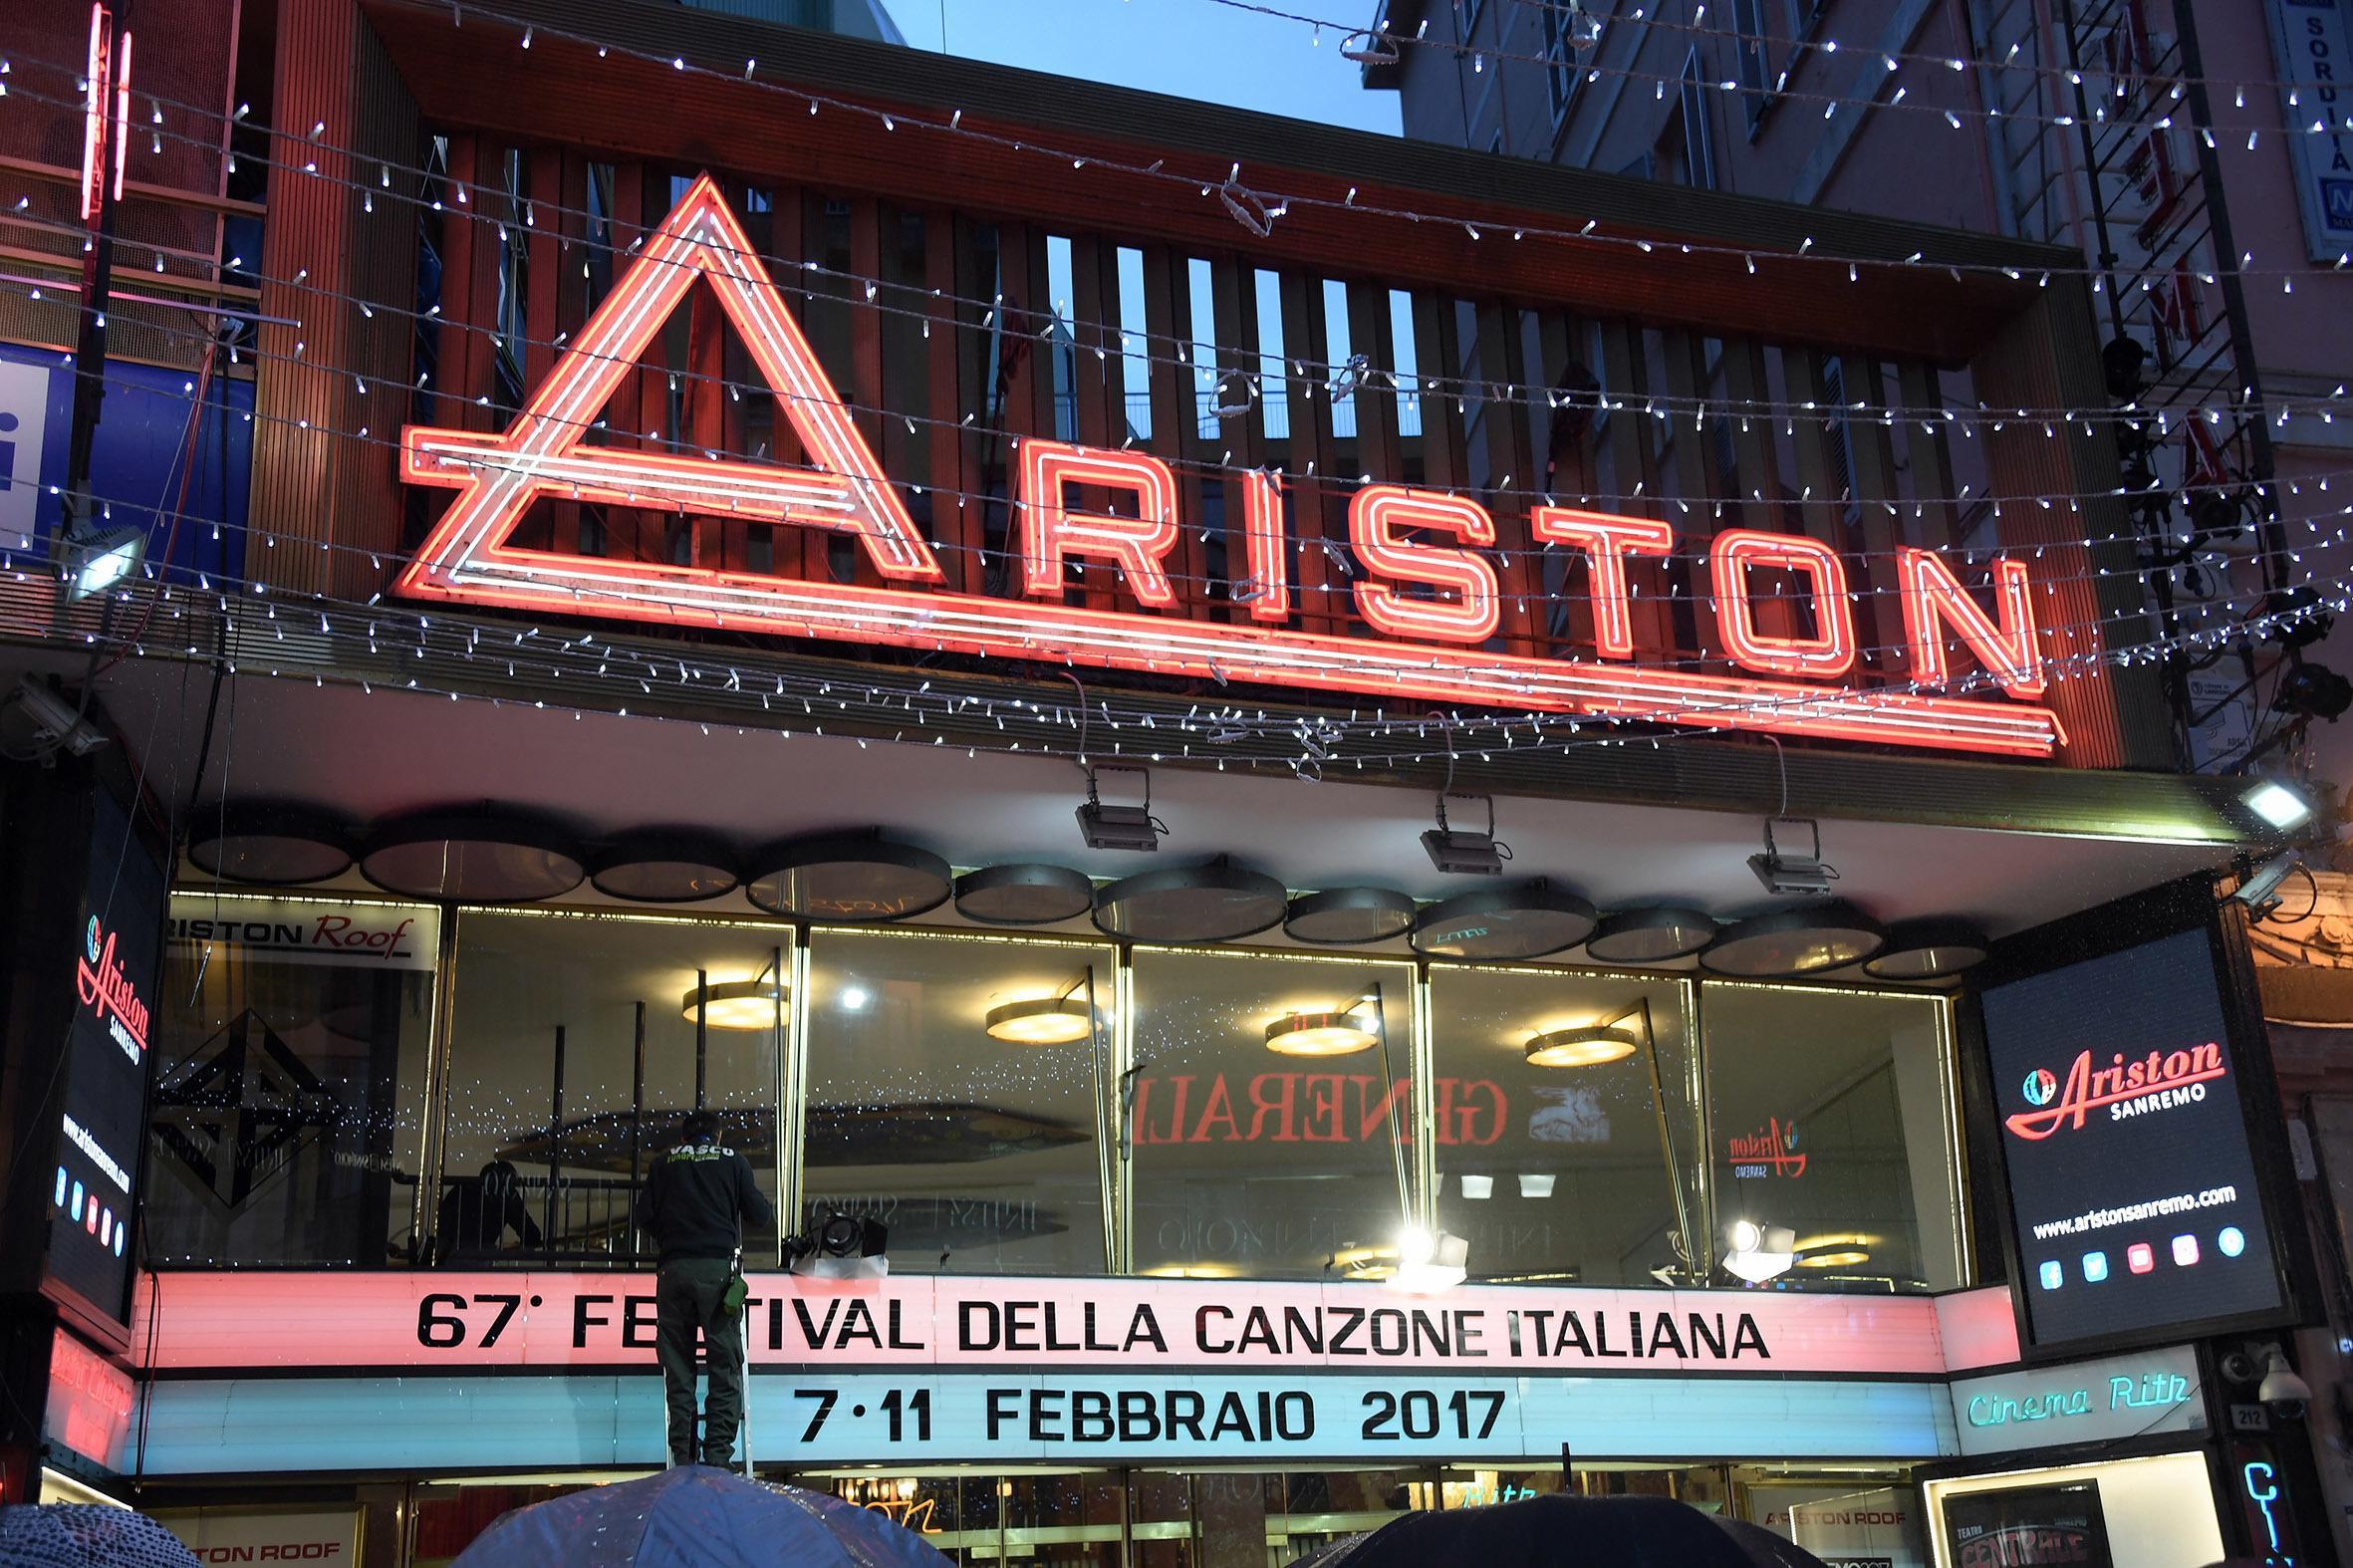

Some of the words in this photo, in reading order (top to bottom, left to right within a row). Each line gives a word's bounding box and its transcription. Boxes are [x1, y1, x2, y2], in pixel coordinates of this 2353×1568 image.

[396, 173, 2054, 702] ARISTON
[311, 915, 415, 960] Roof
[77, 931, 149, 1046] Ariston
[2004, 1042, 2225, 1141] Ariston
[2110, 1082, 2206, 1122] SANREMO
[669, 1145, 735, 1157] VASCO
[2032, 1185, 2236, 1240] www.aristonsanremo.com
[572, 1295, 925, 1351] FEIVAL
[957, 1300, 1169, 1354] DELLA
[1194, 1304, 1485, 1357] CANZONE
[1507, 1309, 1771, 1360] ITALIANA
[986, 1389, 1316, 1442] FEBBRAIO
[1361, 1390, 1506, 1440] 2017
[1967, 1389, 2091, 1428] Cinema
[2238, 1411, 2261, 1425] 212
[1765, 1512, 1851, 1525] ARSTON
[1854, 1512, 1907, 1525] ROOF
[259, 1542, 341, 1562] ROOF
